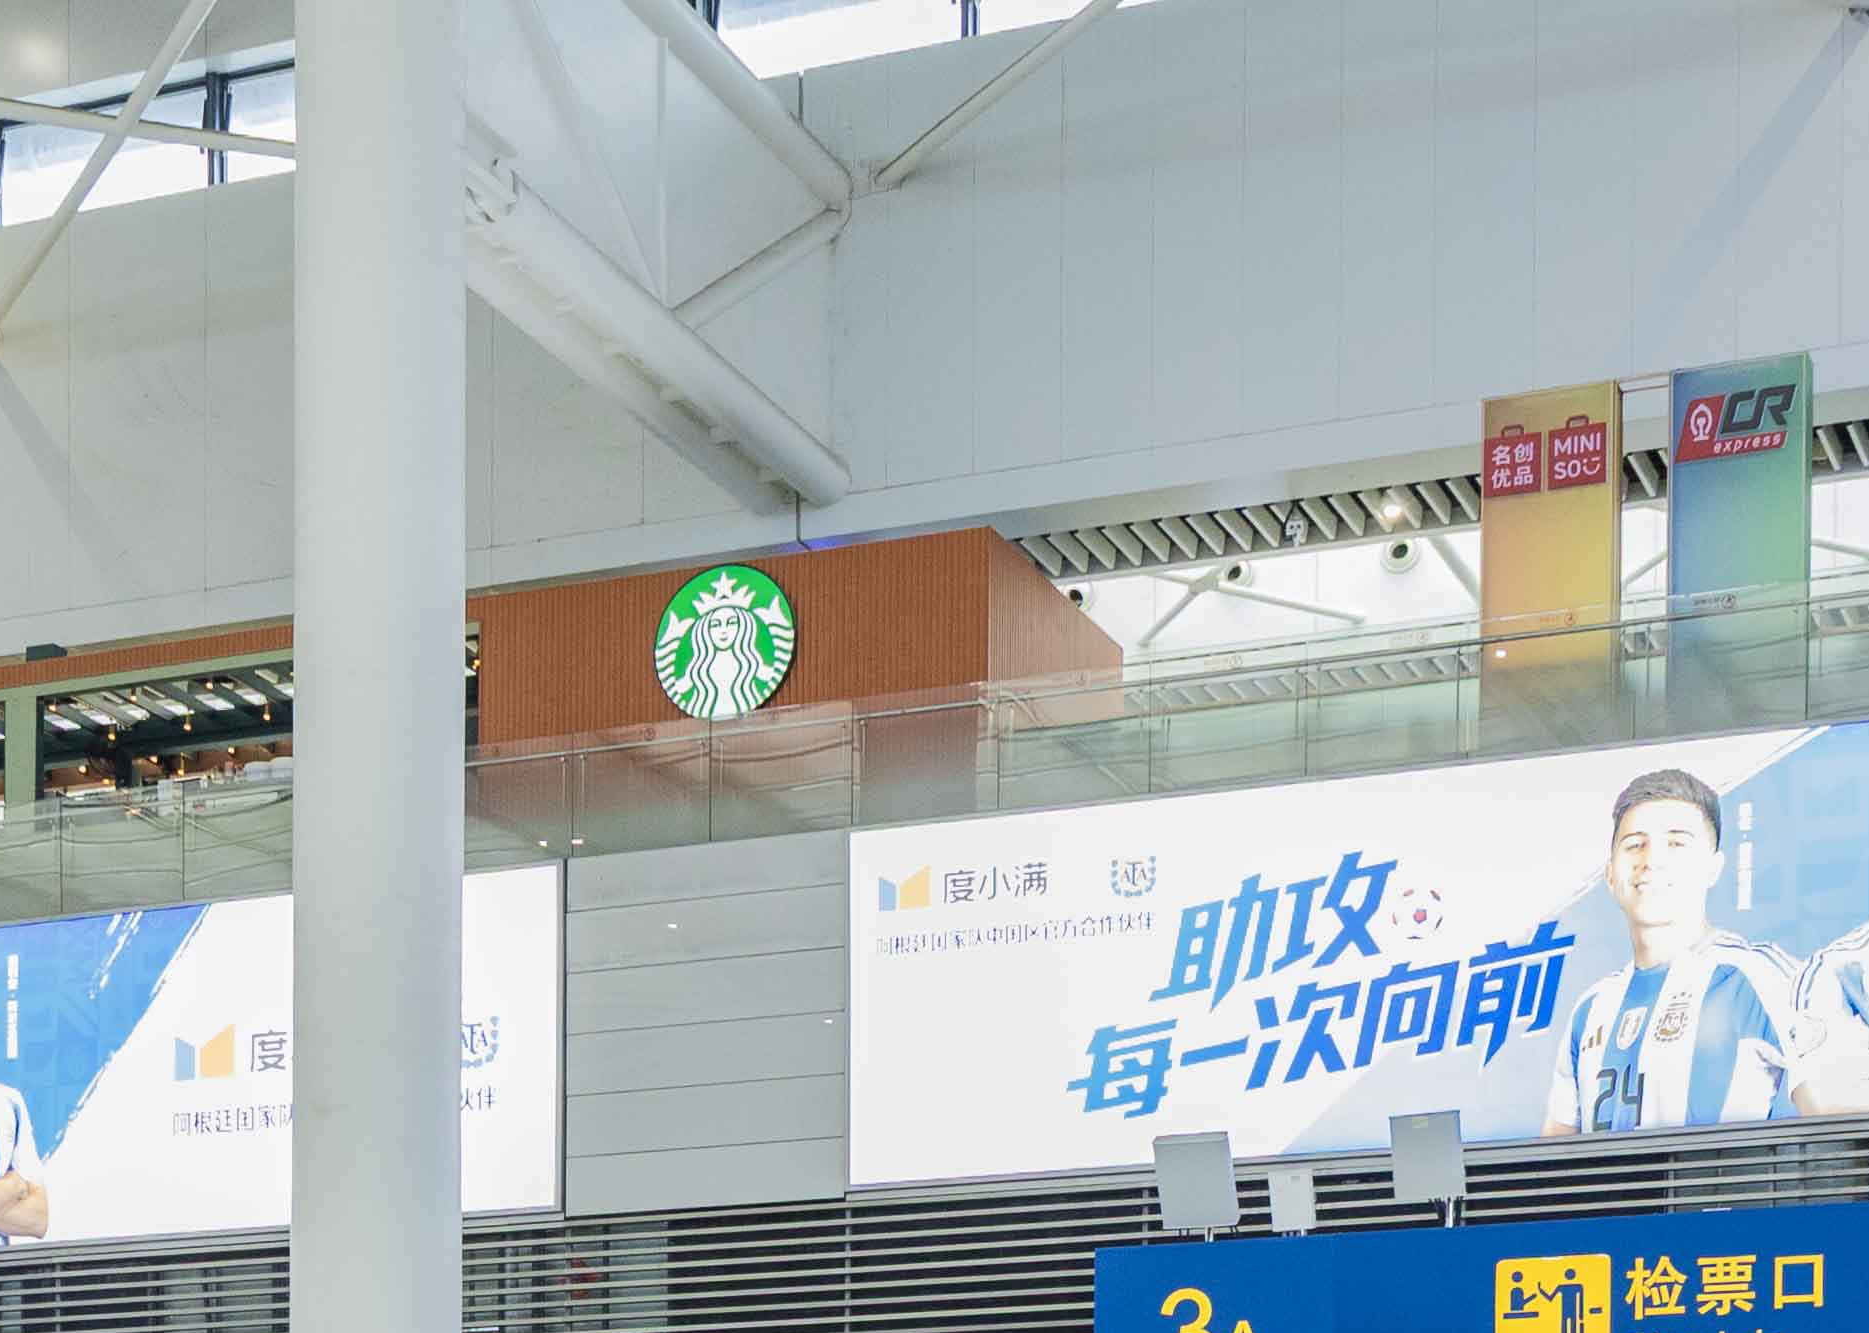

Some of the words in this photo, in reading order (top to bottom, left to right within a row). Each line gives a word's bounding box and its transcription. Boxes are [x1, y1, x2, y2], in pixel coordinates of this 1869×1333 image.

[1491, 441, 1533, 465] 名创
[1554, 432, 1602, 457] MINI
[1714, 432, 1781, 453] express
[1491, 467, 1533, 488] 优品
[944, 863, 1048, 904] 度小满
[1149, 851, 1398, 1012] 助攻
[1066, 921, 1575, 1119] 每一次向前
[1625, 1253, 1826, 1318] 检票口
